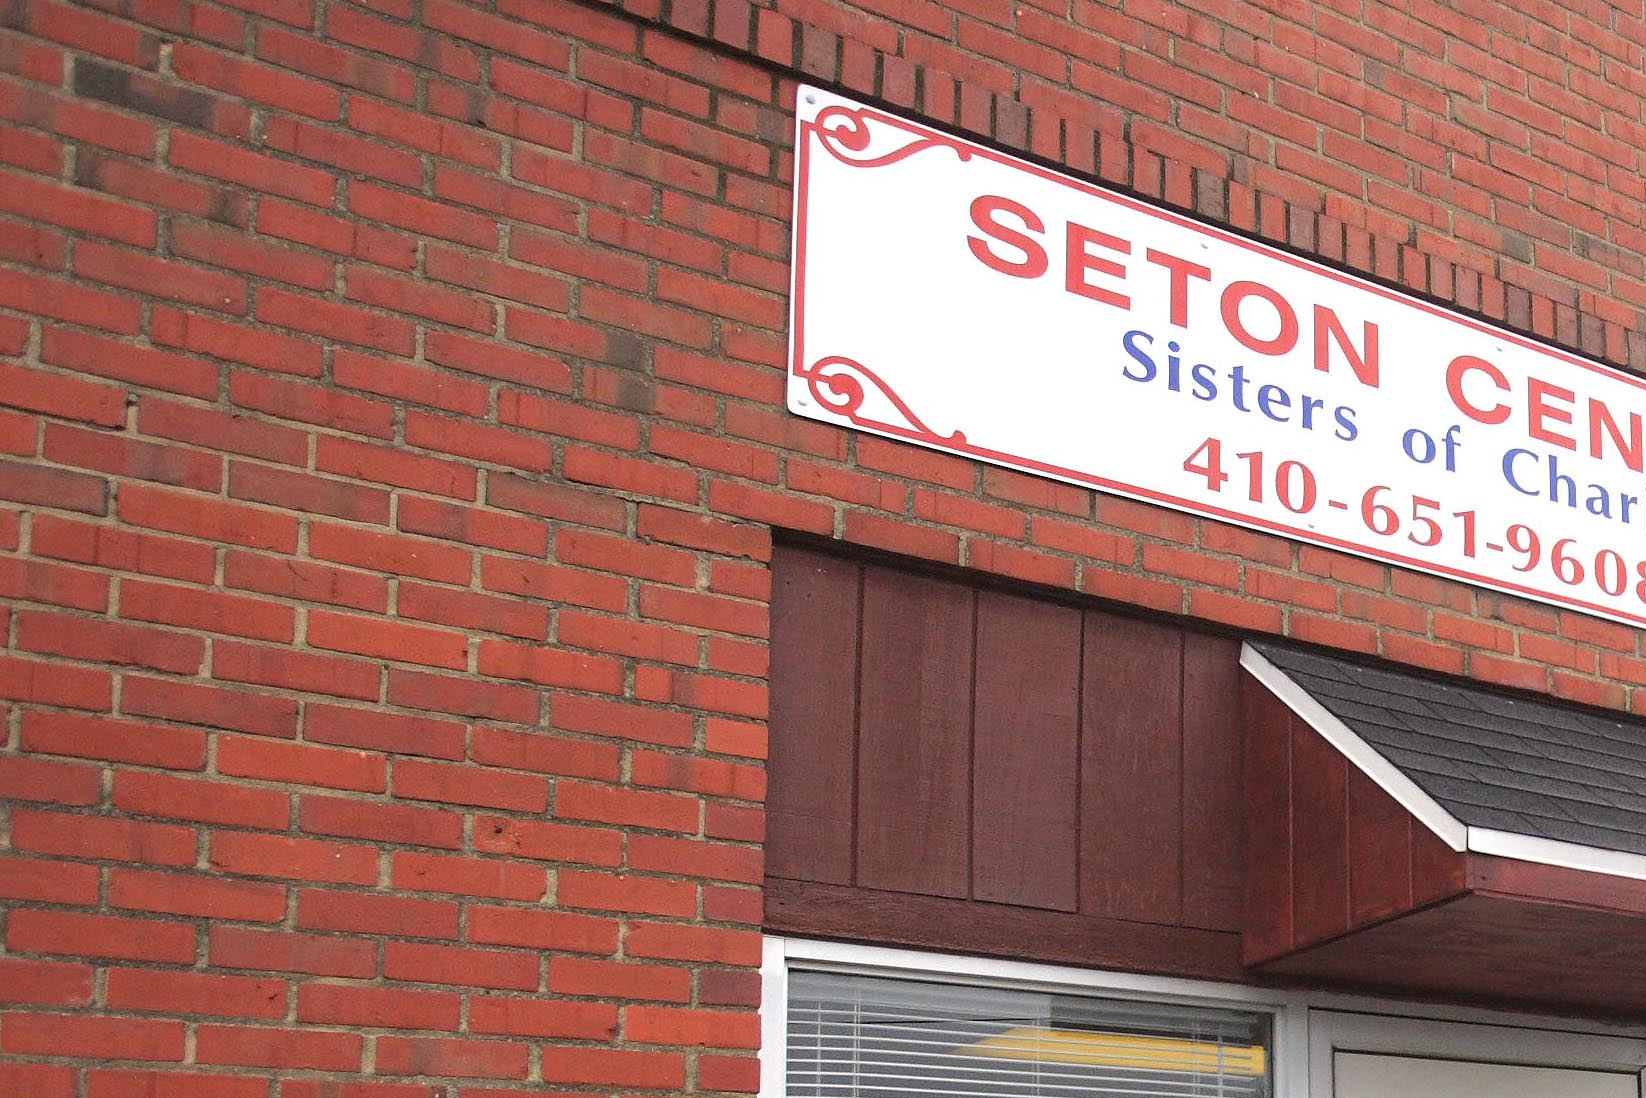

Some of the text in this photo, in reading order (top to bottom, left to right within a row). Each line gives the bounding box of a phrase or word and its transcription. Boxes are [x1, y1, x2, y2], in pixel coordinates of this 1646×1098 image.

[967, 194, 1380, 389] SETON
[1122, 329, 1359, 442] Sisters
[1402, 424, 1462, 473] of
